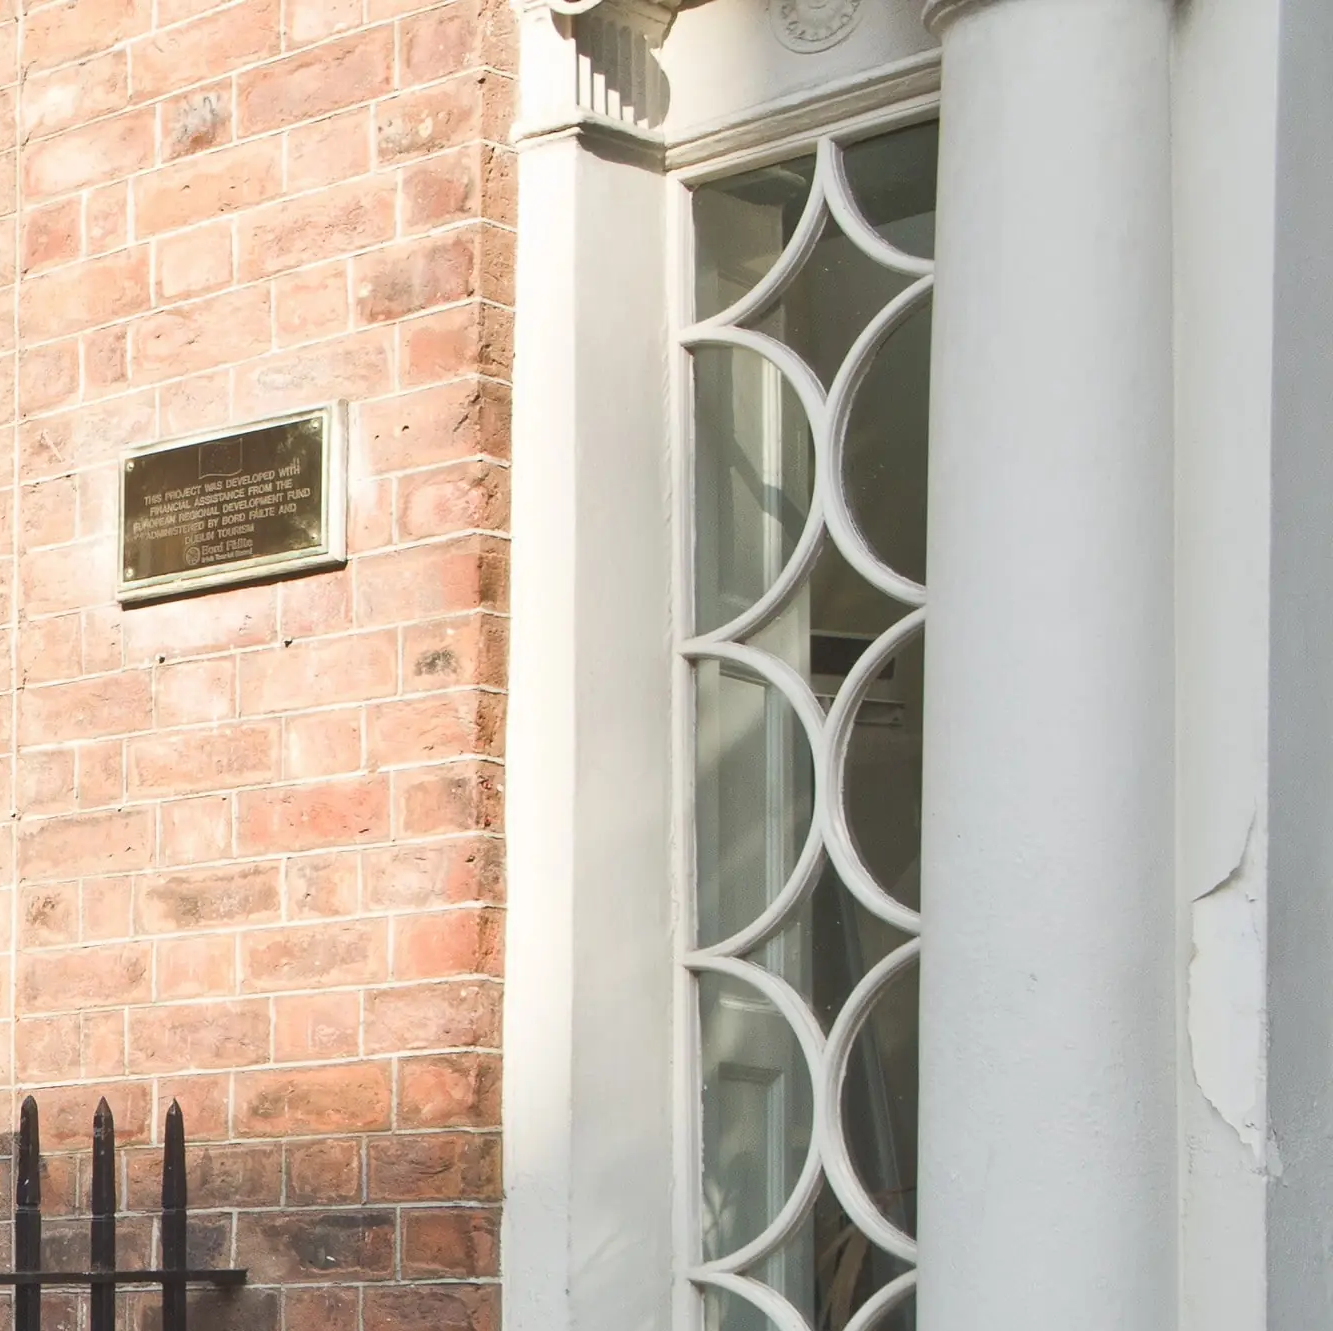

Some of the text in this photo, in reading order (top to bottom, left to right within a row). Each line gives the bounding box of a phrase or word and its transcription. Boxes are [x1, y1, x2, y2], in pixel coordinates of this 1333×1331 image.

[149, 479, 293, 517] FINANCIAL ASSISTANCE FROM THE
[164, 485, 202, 501] PROJECT
[204, 480, 223, 493] WAS
[225, 470, 275, 489] DEVELOPED
[278, 465, 300, 478] WITH
[178, 506, 221, 522] REGIONAL
[222, 493, 284, 513] DEVELOPMENT
[286, 488, 311, 501] FUND
[207, 518, 220, 529] BY
[222, 513, 246, 526] BORD
[278, 503, 297, 515] AND
[184, 523, 255, 546] DUBLIN TOURISM
[201, 541, 224, 556] Bord
